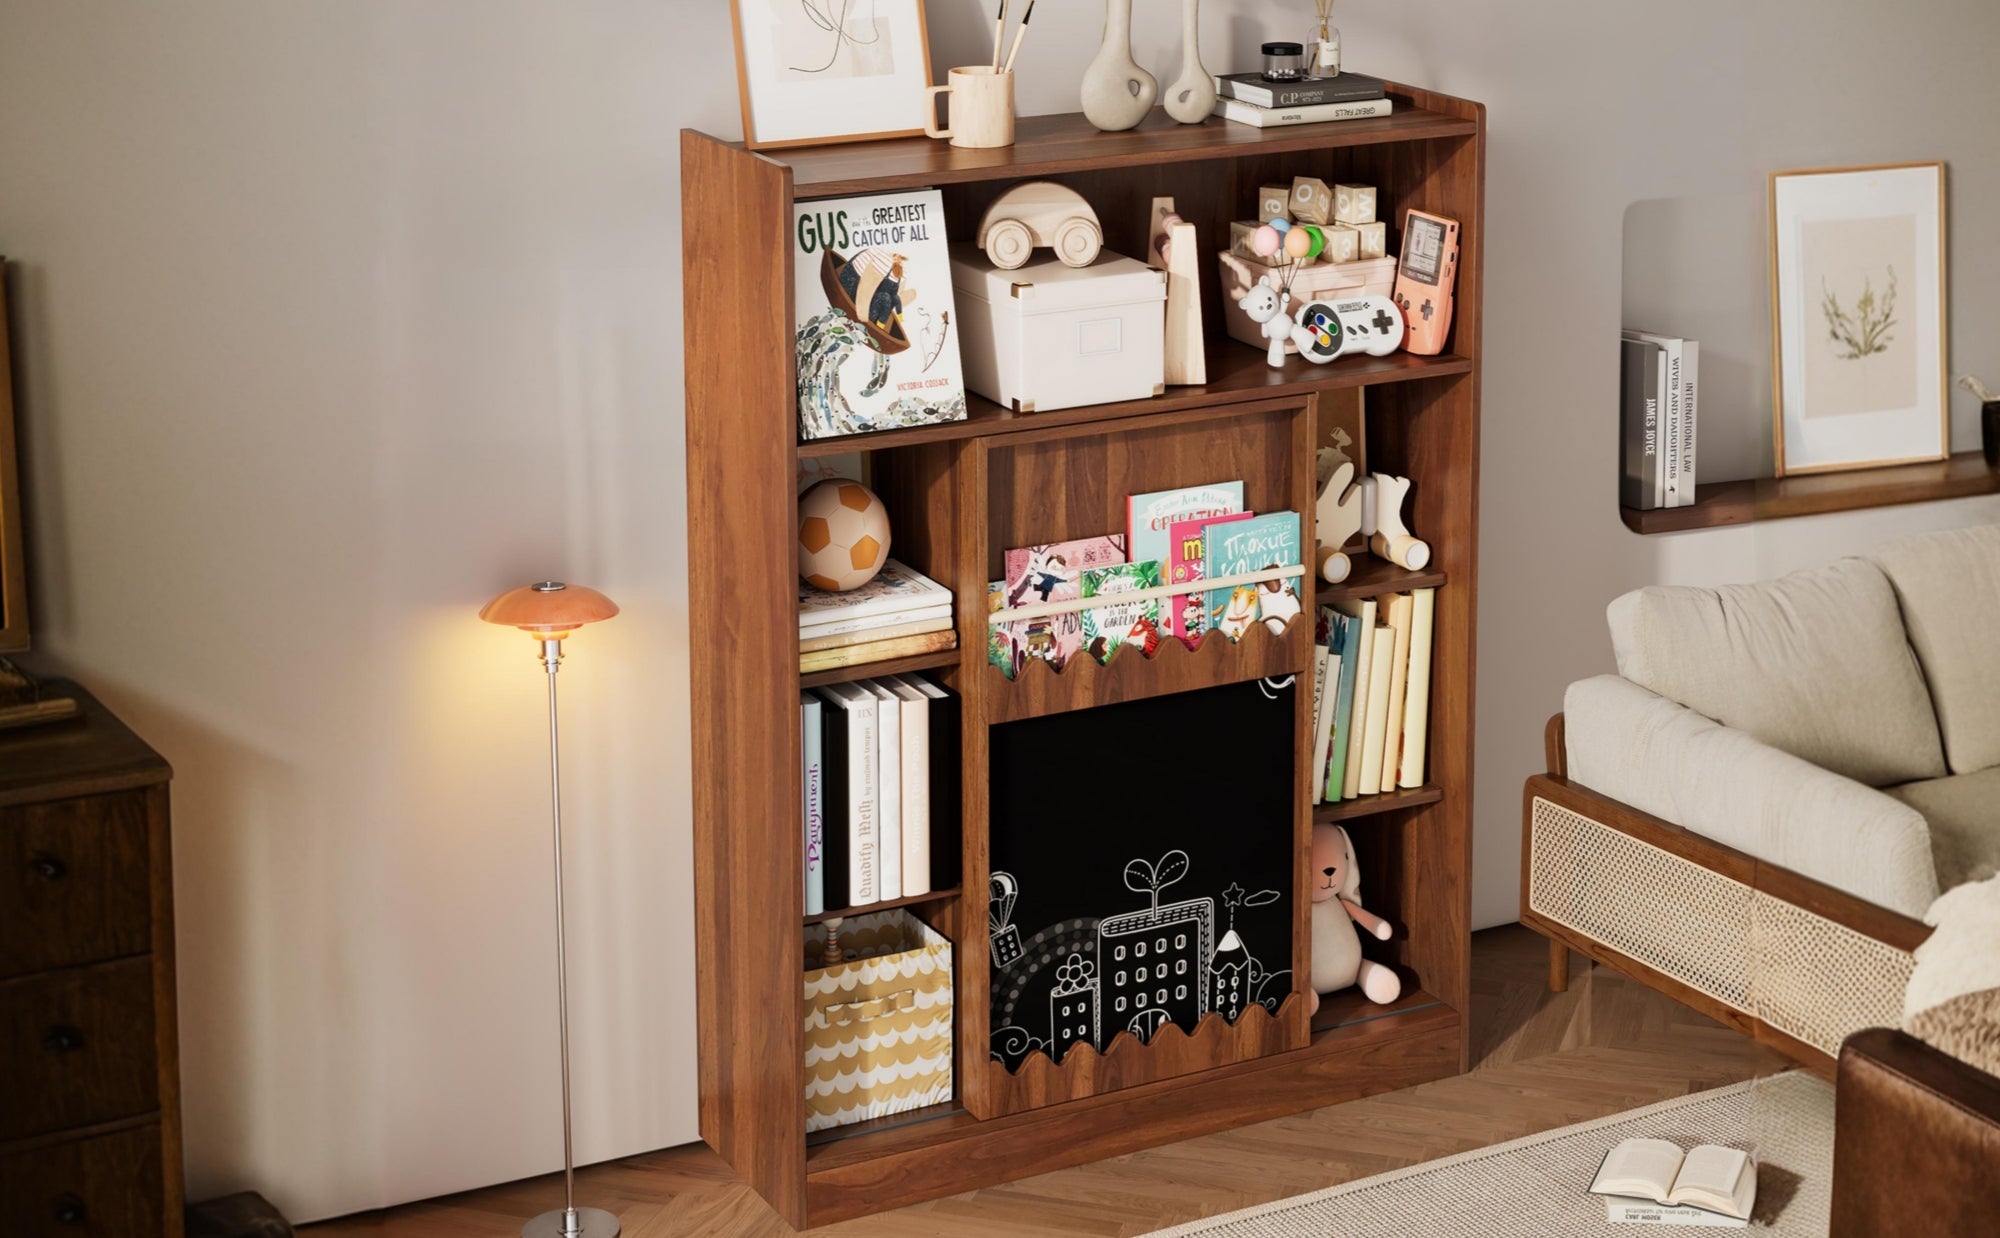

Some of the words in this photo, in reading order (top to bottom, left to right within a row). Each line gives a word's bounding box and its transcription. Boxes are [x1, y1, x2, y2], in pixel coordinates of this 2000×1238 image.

[1280, 92, 1299, 104] C.P.
[1335, 109, 1354, 117] FALLS
[1355, 107, 1375, 116] GREAT
[872, 203, 926, 225] GREATEST
[798, 210, 849, 254] GUS
[852, 229, 888, 248] CATCH
[891, 226, 907, 245] OF
[910, 224, 929, 242] ALL
[1672, 357, 1680, 390] WIVES
[896, 381, 924, 392] VICTORIA
[1646, 398, 1656, 427] JAMES
[1671, 392, 1679, 415] AND
[1683, 382, 1693, 452] INTERNATIONAL
[1645, 429, 1656, 457] JOYCE
[1669, 417, 1679, 480] DAUGHTERS
[1683, 454, 1692, 473] LAW
[1104, 614, 1137, 629] GARDEN
